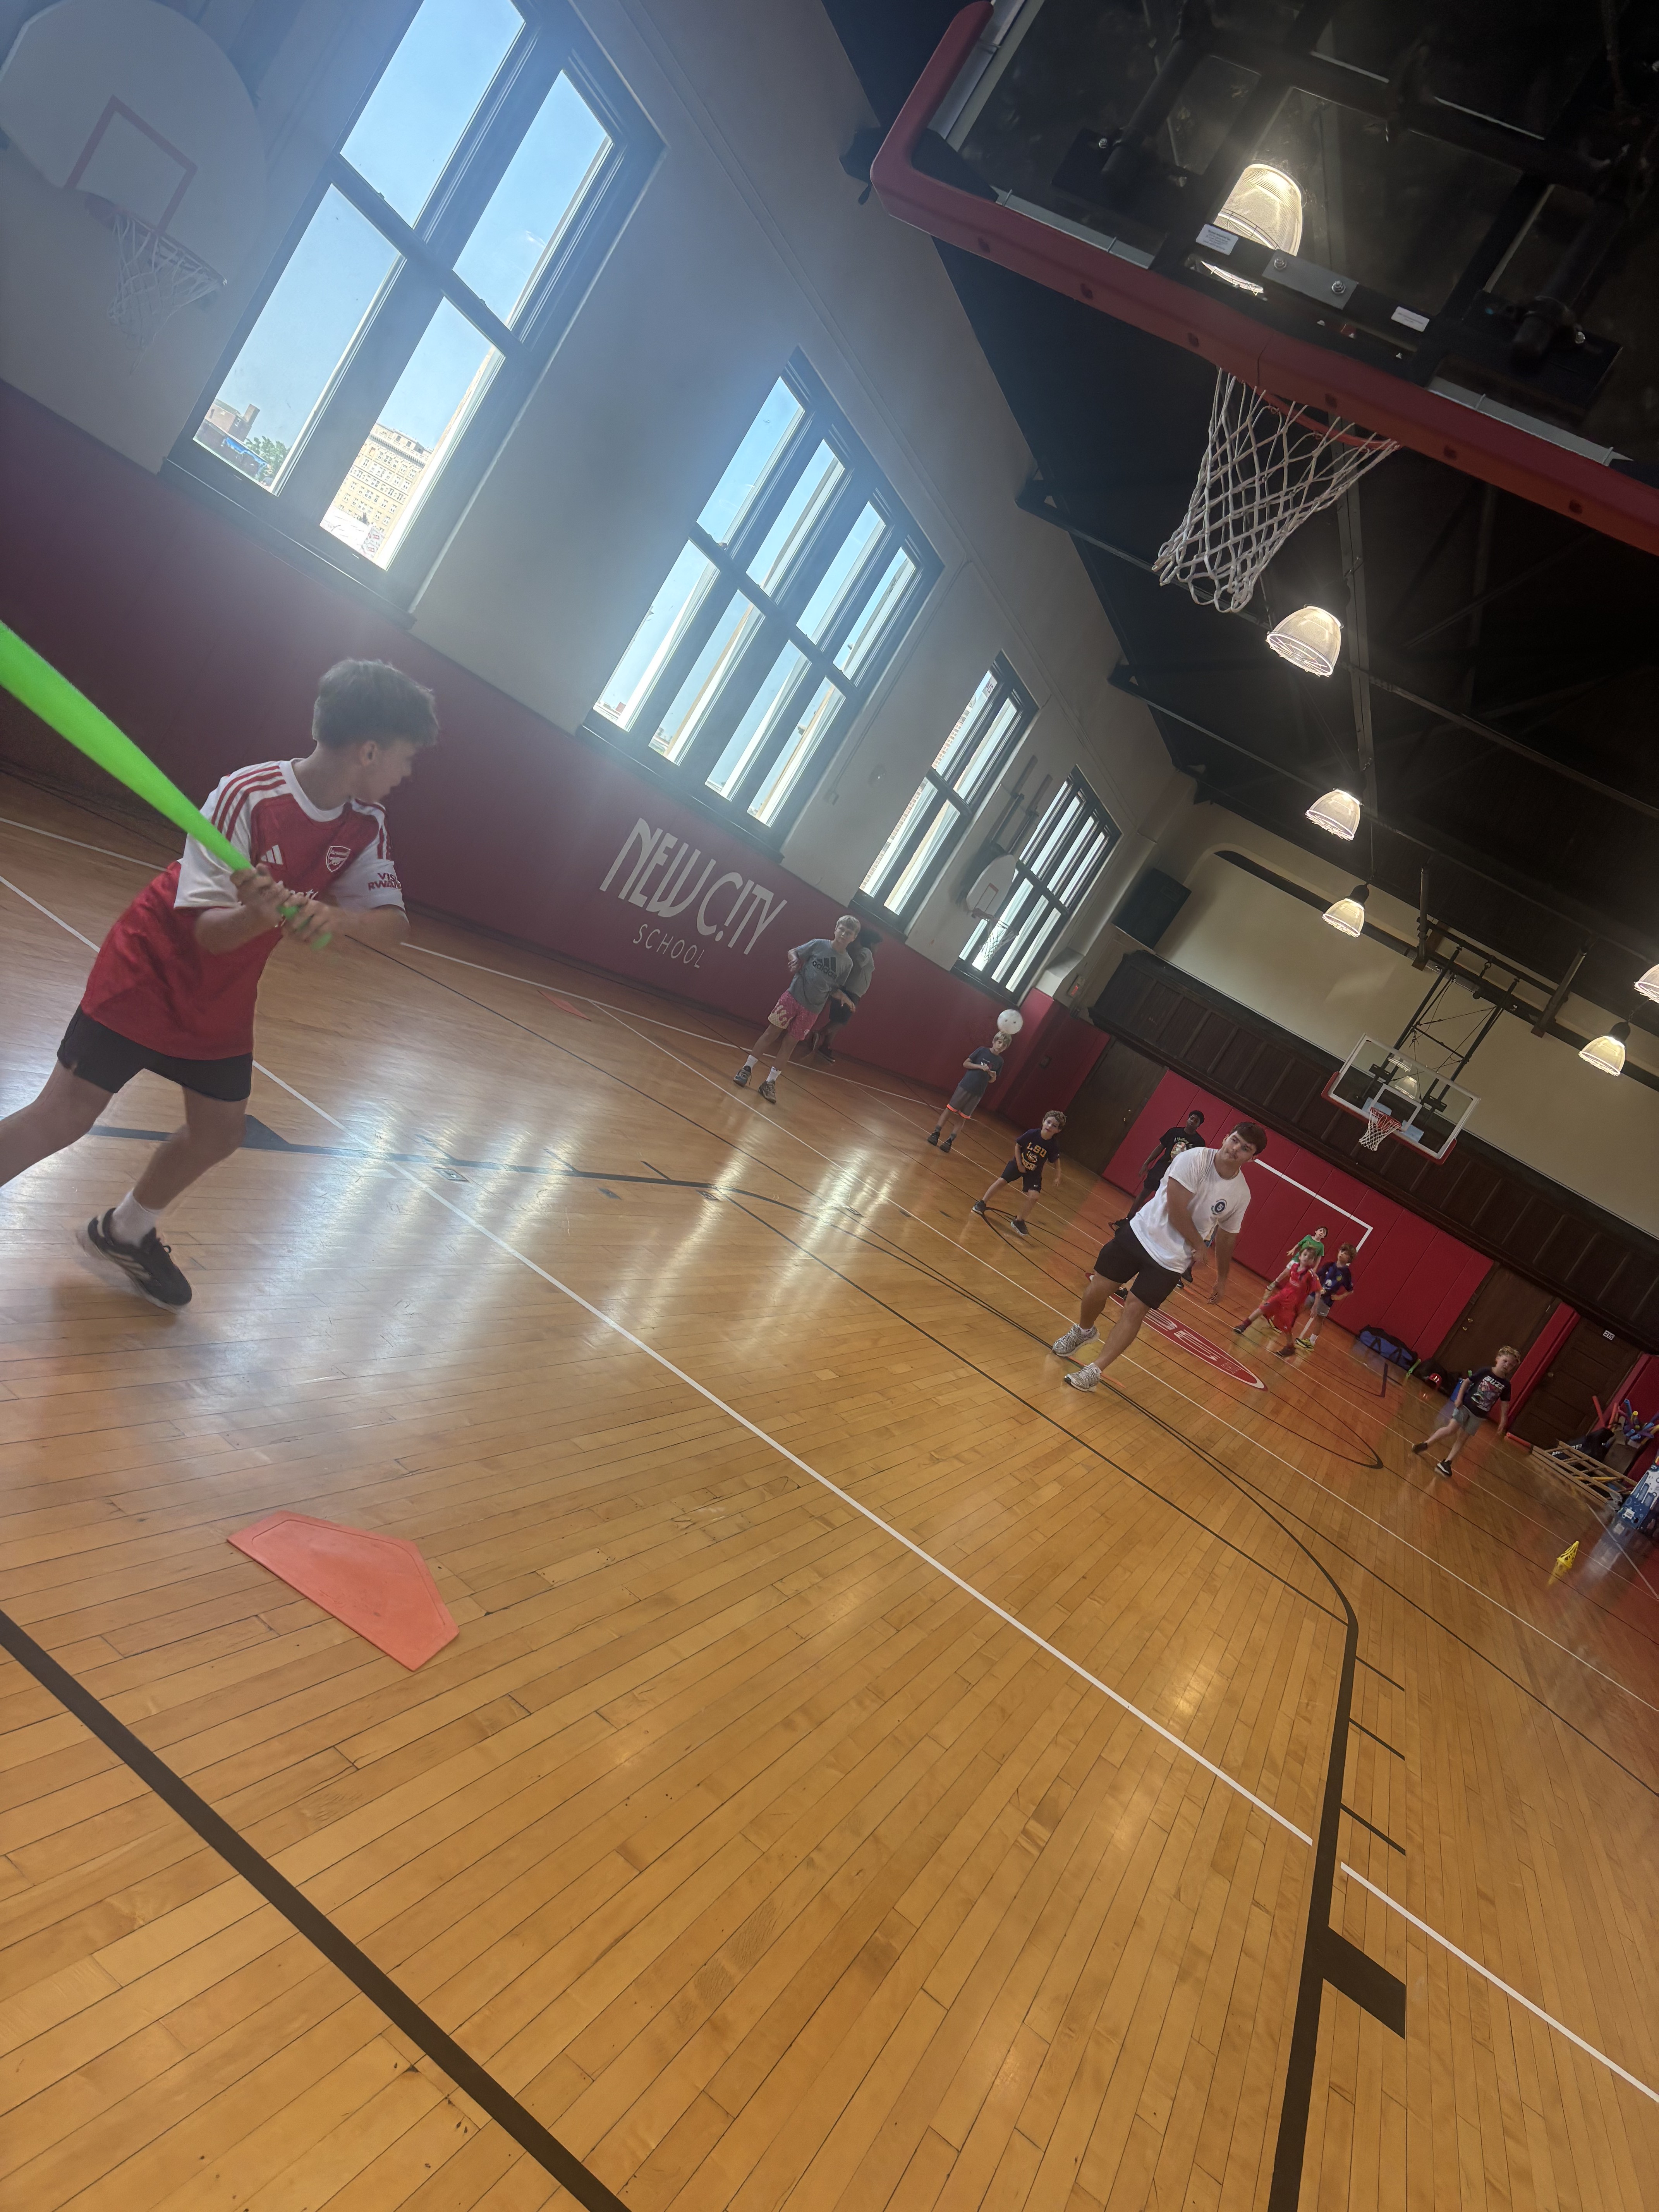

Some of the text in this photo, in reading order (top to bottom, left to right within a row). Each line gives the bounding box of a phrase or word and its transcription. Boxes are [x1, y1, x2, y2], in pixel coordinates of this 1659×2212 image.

[599, 817, 716, 917] NEW
[633, 924, 705, 968] SCHOOL
[812, 960, 837, 979] adidas
